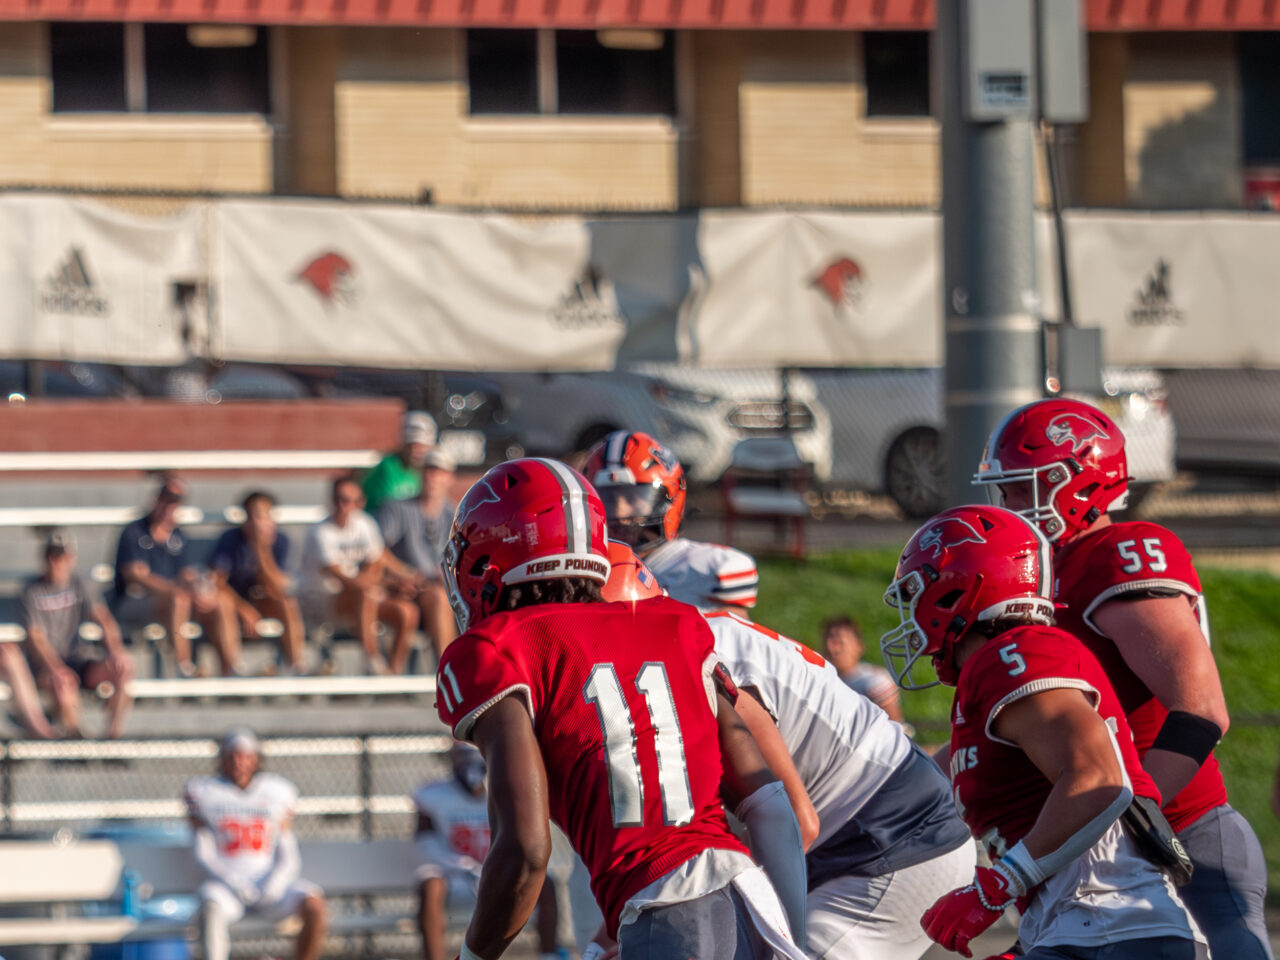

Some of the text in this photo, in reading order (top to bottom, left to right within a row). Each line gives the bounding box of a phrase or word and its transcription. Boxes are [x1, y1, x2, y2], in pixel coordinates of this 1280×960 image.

[526, 559, 561, 576] KEEP
[1117, 537, 1168, 574] 55
[1005, 603, 1034, 614] KEEP
[998, 642, 1027, 677] 5
[438, 660, 465, 714] 11
[582, 660, 696, 829] 11
